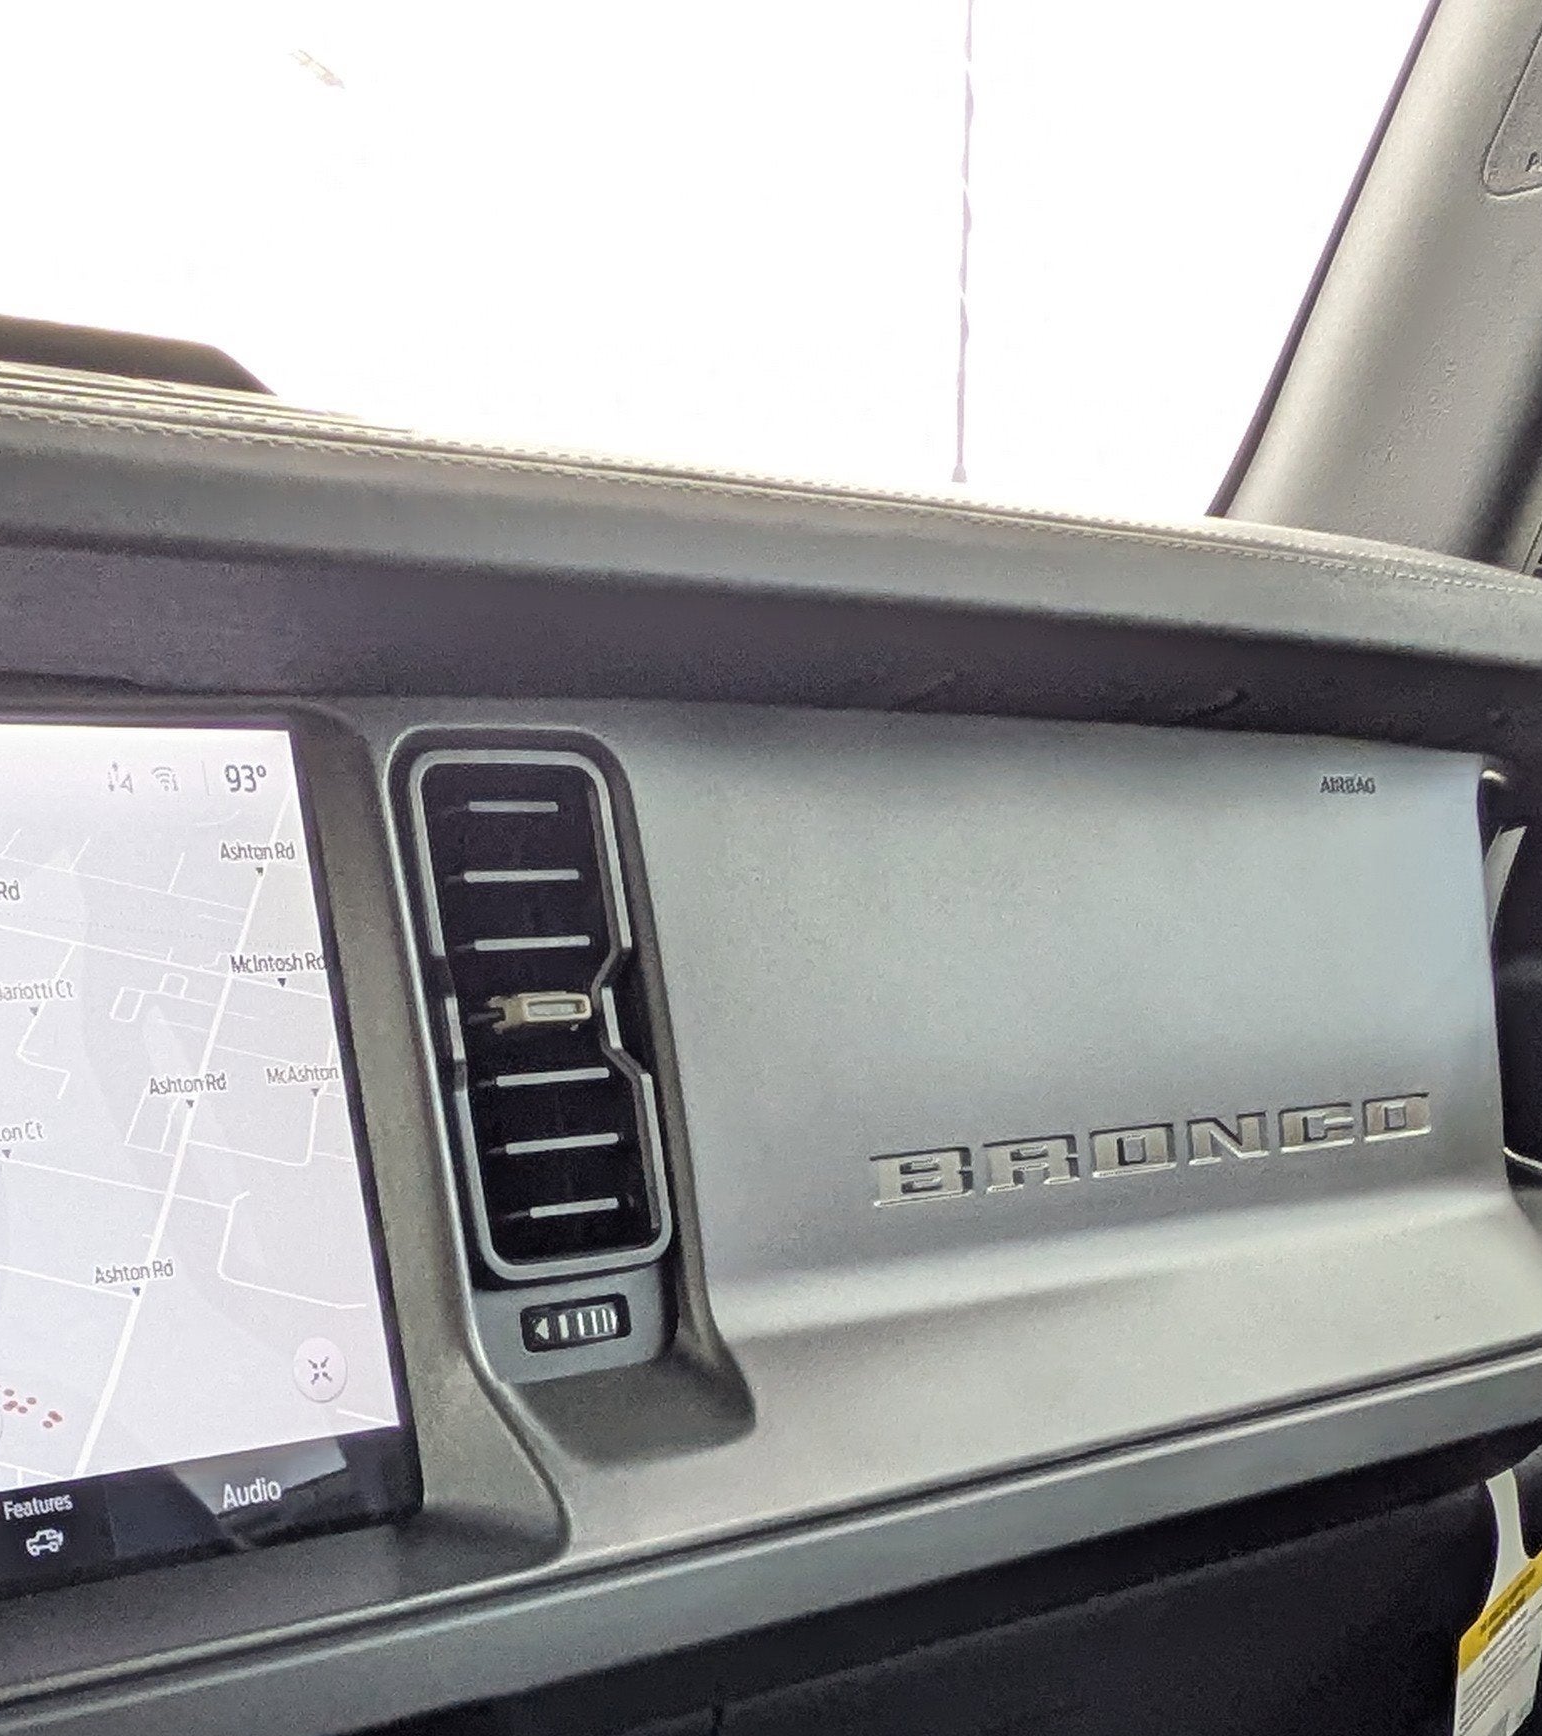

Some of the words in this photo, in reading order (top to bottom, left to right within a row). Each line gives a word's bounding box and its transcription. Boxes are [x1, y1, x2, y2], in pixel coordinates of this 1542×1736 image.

[220, 842, 273, 860] Ashton
[275, 841, 295, 859] Rd
[230, 953, 303, 973] McIntosh
[55, 979, 73, 998] Ct
[150, 1076, 202, 1095] Ashton
[205, 1073, 227, 1092] Rd
[25, 1121, 44, 1140] Ct
[870, 1092, 1431, 1206] BRONCO
[95, 1263, 150, 1284] Ashton
[152, 1259, 174, 1279] Rd
[222, 1477, 282, 1509] Audio
[3, 1491, 73, 1521] Features
